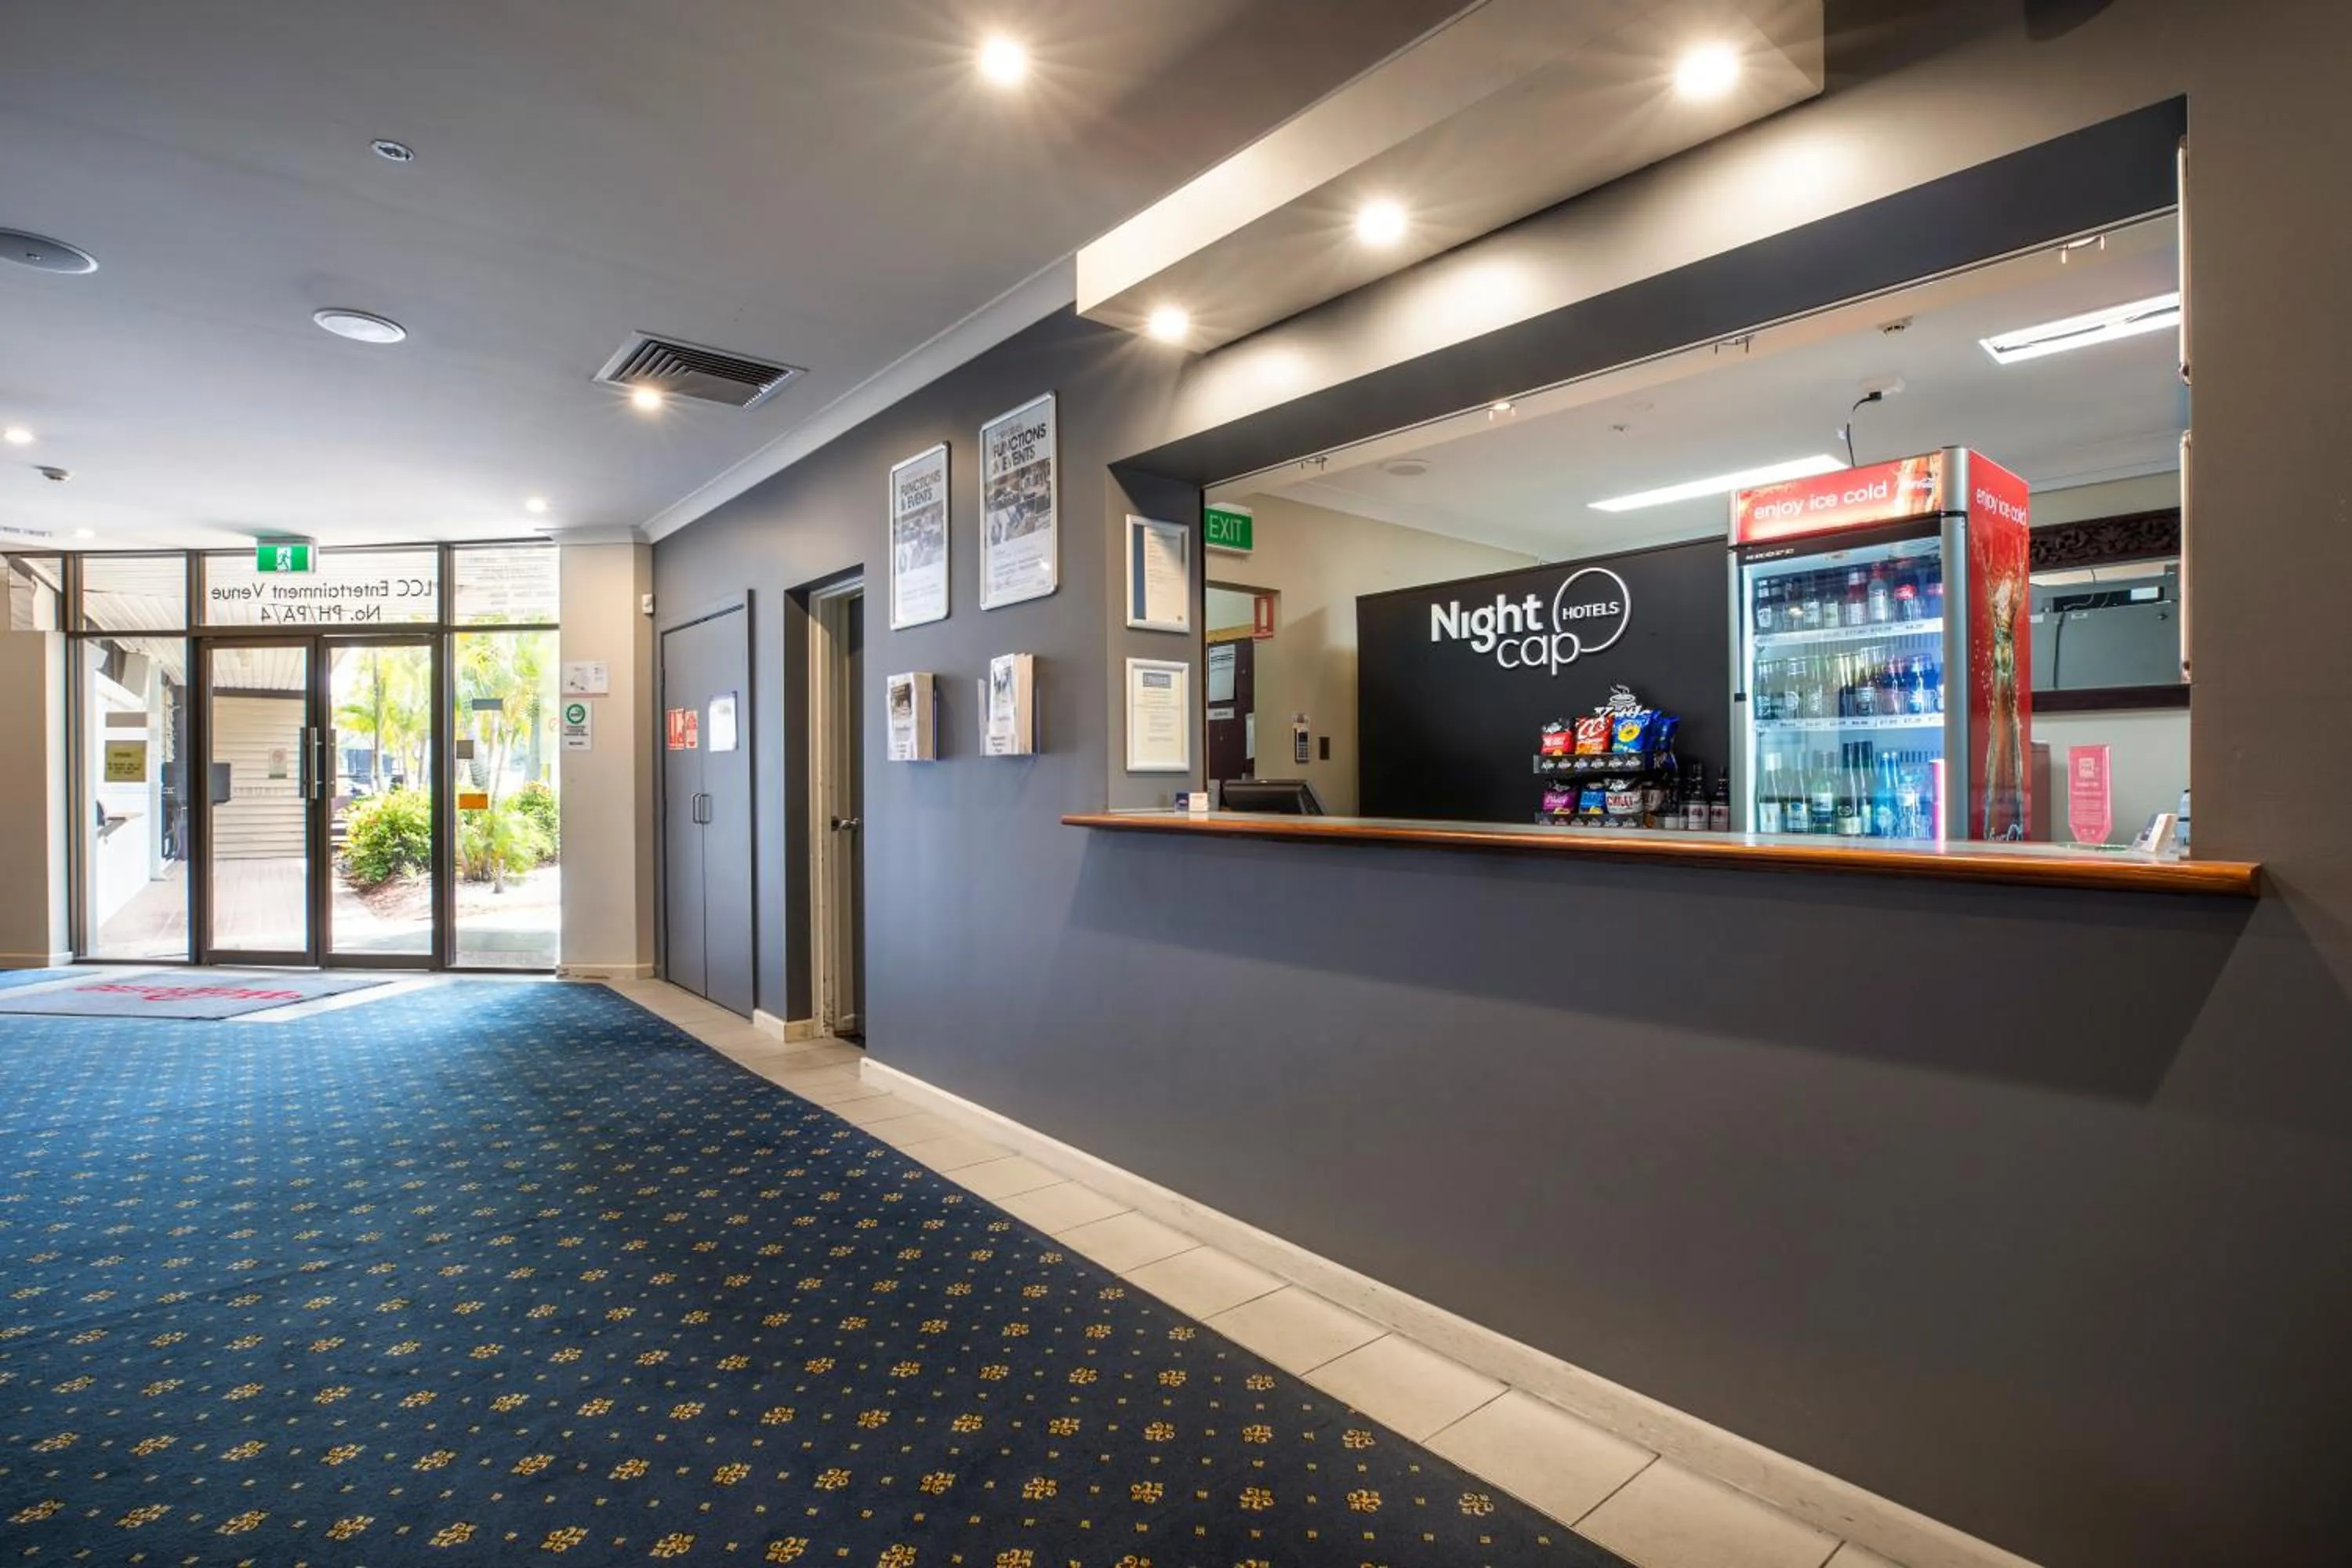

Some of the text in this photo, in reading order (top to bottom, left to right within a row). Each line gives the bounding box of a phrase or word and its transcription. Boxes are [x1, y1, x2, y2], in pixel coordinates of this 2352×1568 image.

[993, 423, 1047, 458] FUNCTIONS
[1003, 445, 1036, 470] EVENTS
[901, 470, 942, 496] FUNCTIONS
[907, 488, 933, 510] EVENTS
[1754, 500, 1804, 520] enjoy
[1809, 492, 1838, 510] ice
[1843, 480, 1888, 504] cold
[1209, 514, 1243, 543] EXIT
[1431, 593, 1621, 653] Night HOTELS
[1497, 632, 1581, 676] cap
